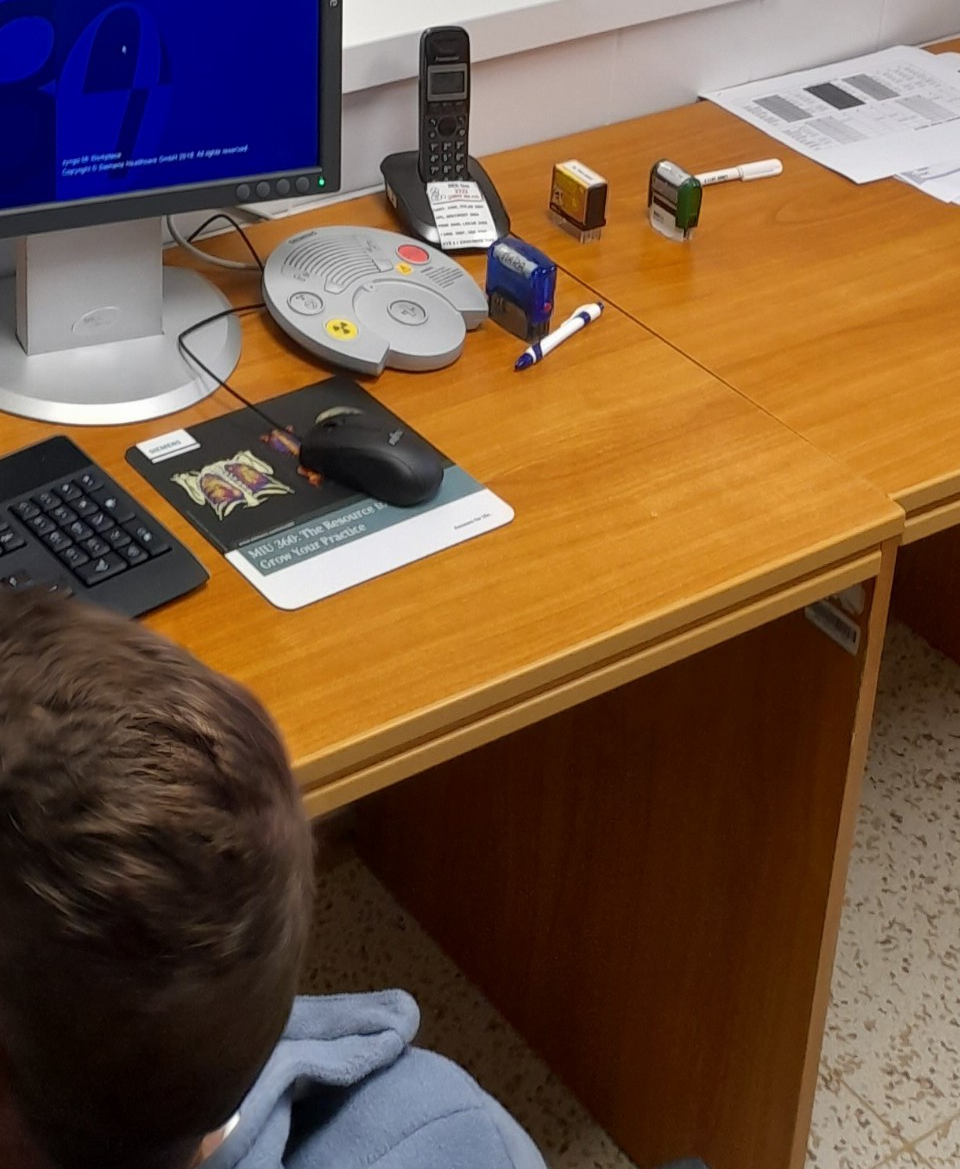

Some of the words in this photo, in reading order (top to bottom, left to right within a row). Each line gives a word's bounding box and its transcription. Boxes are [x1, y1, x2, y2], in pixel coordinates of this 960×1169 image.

[299, 525, 324, 538] The
[322, 506, 375, 530] Resource
[260, 551, 292, 569] Grow
[291, 541, 320, 556] Your
[320, 523, 367, 546] Practice
